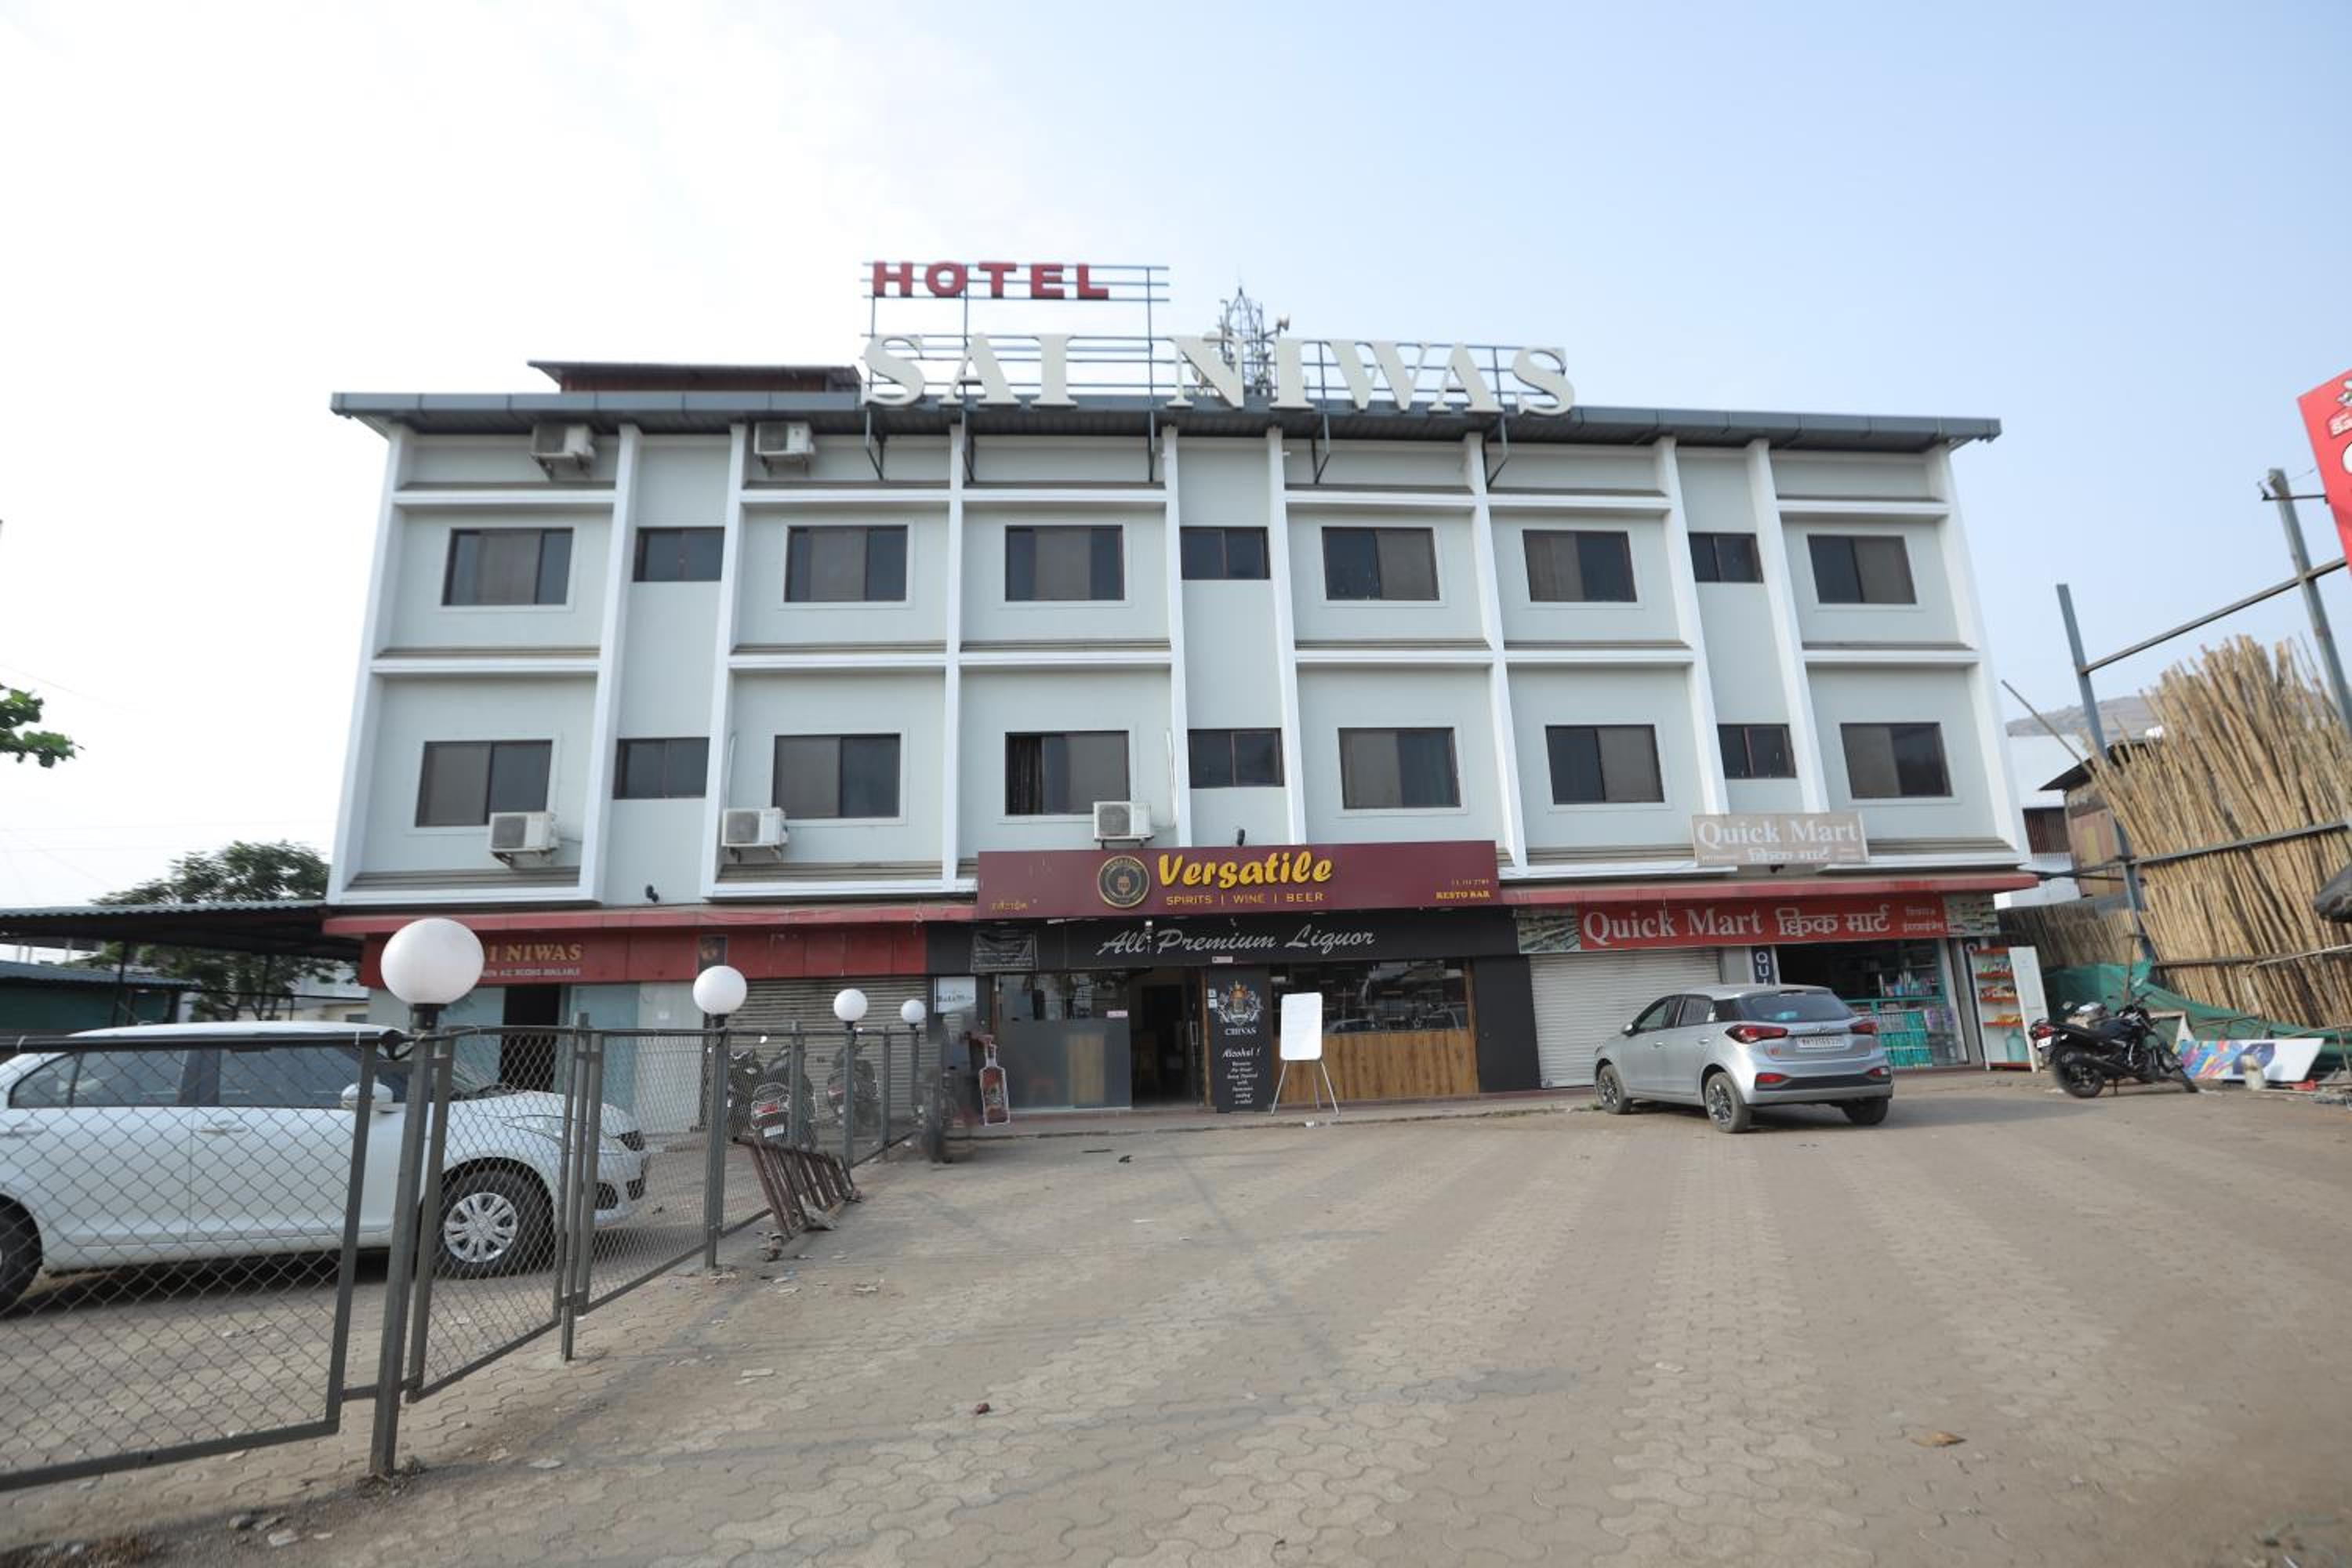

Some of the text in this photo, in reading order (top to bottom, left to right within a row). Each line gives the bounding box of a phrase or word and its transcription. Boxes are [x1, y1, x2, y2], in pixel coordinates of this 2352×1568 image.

[871, 261, 1109, 299] HOTEL
[860, 332, 1575, 417] SAI NIWAS
[1697, 818, 1860, 850] Quick Mart
[1157, 851, 1333, 889] Versatile
[1165, 892, 1325, 906] SPIRITS WINE BEER
[1583, 907, 1764, 946] Quick Mart
[1843, 903, 1891, 933] मार्ट
[505, 942, 583, 962] NIWAS
[1096, 924, 1376, 956] All Premium Liquor
